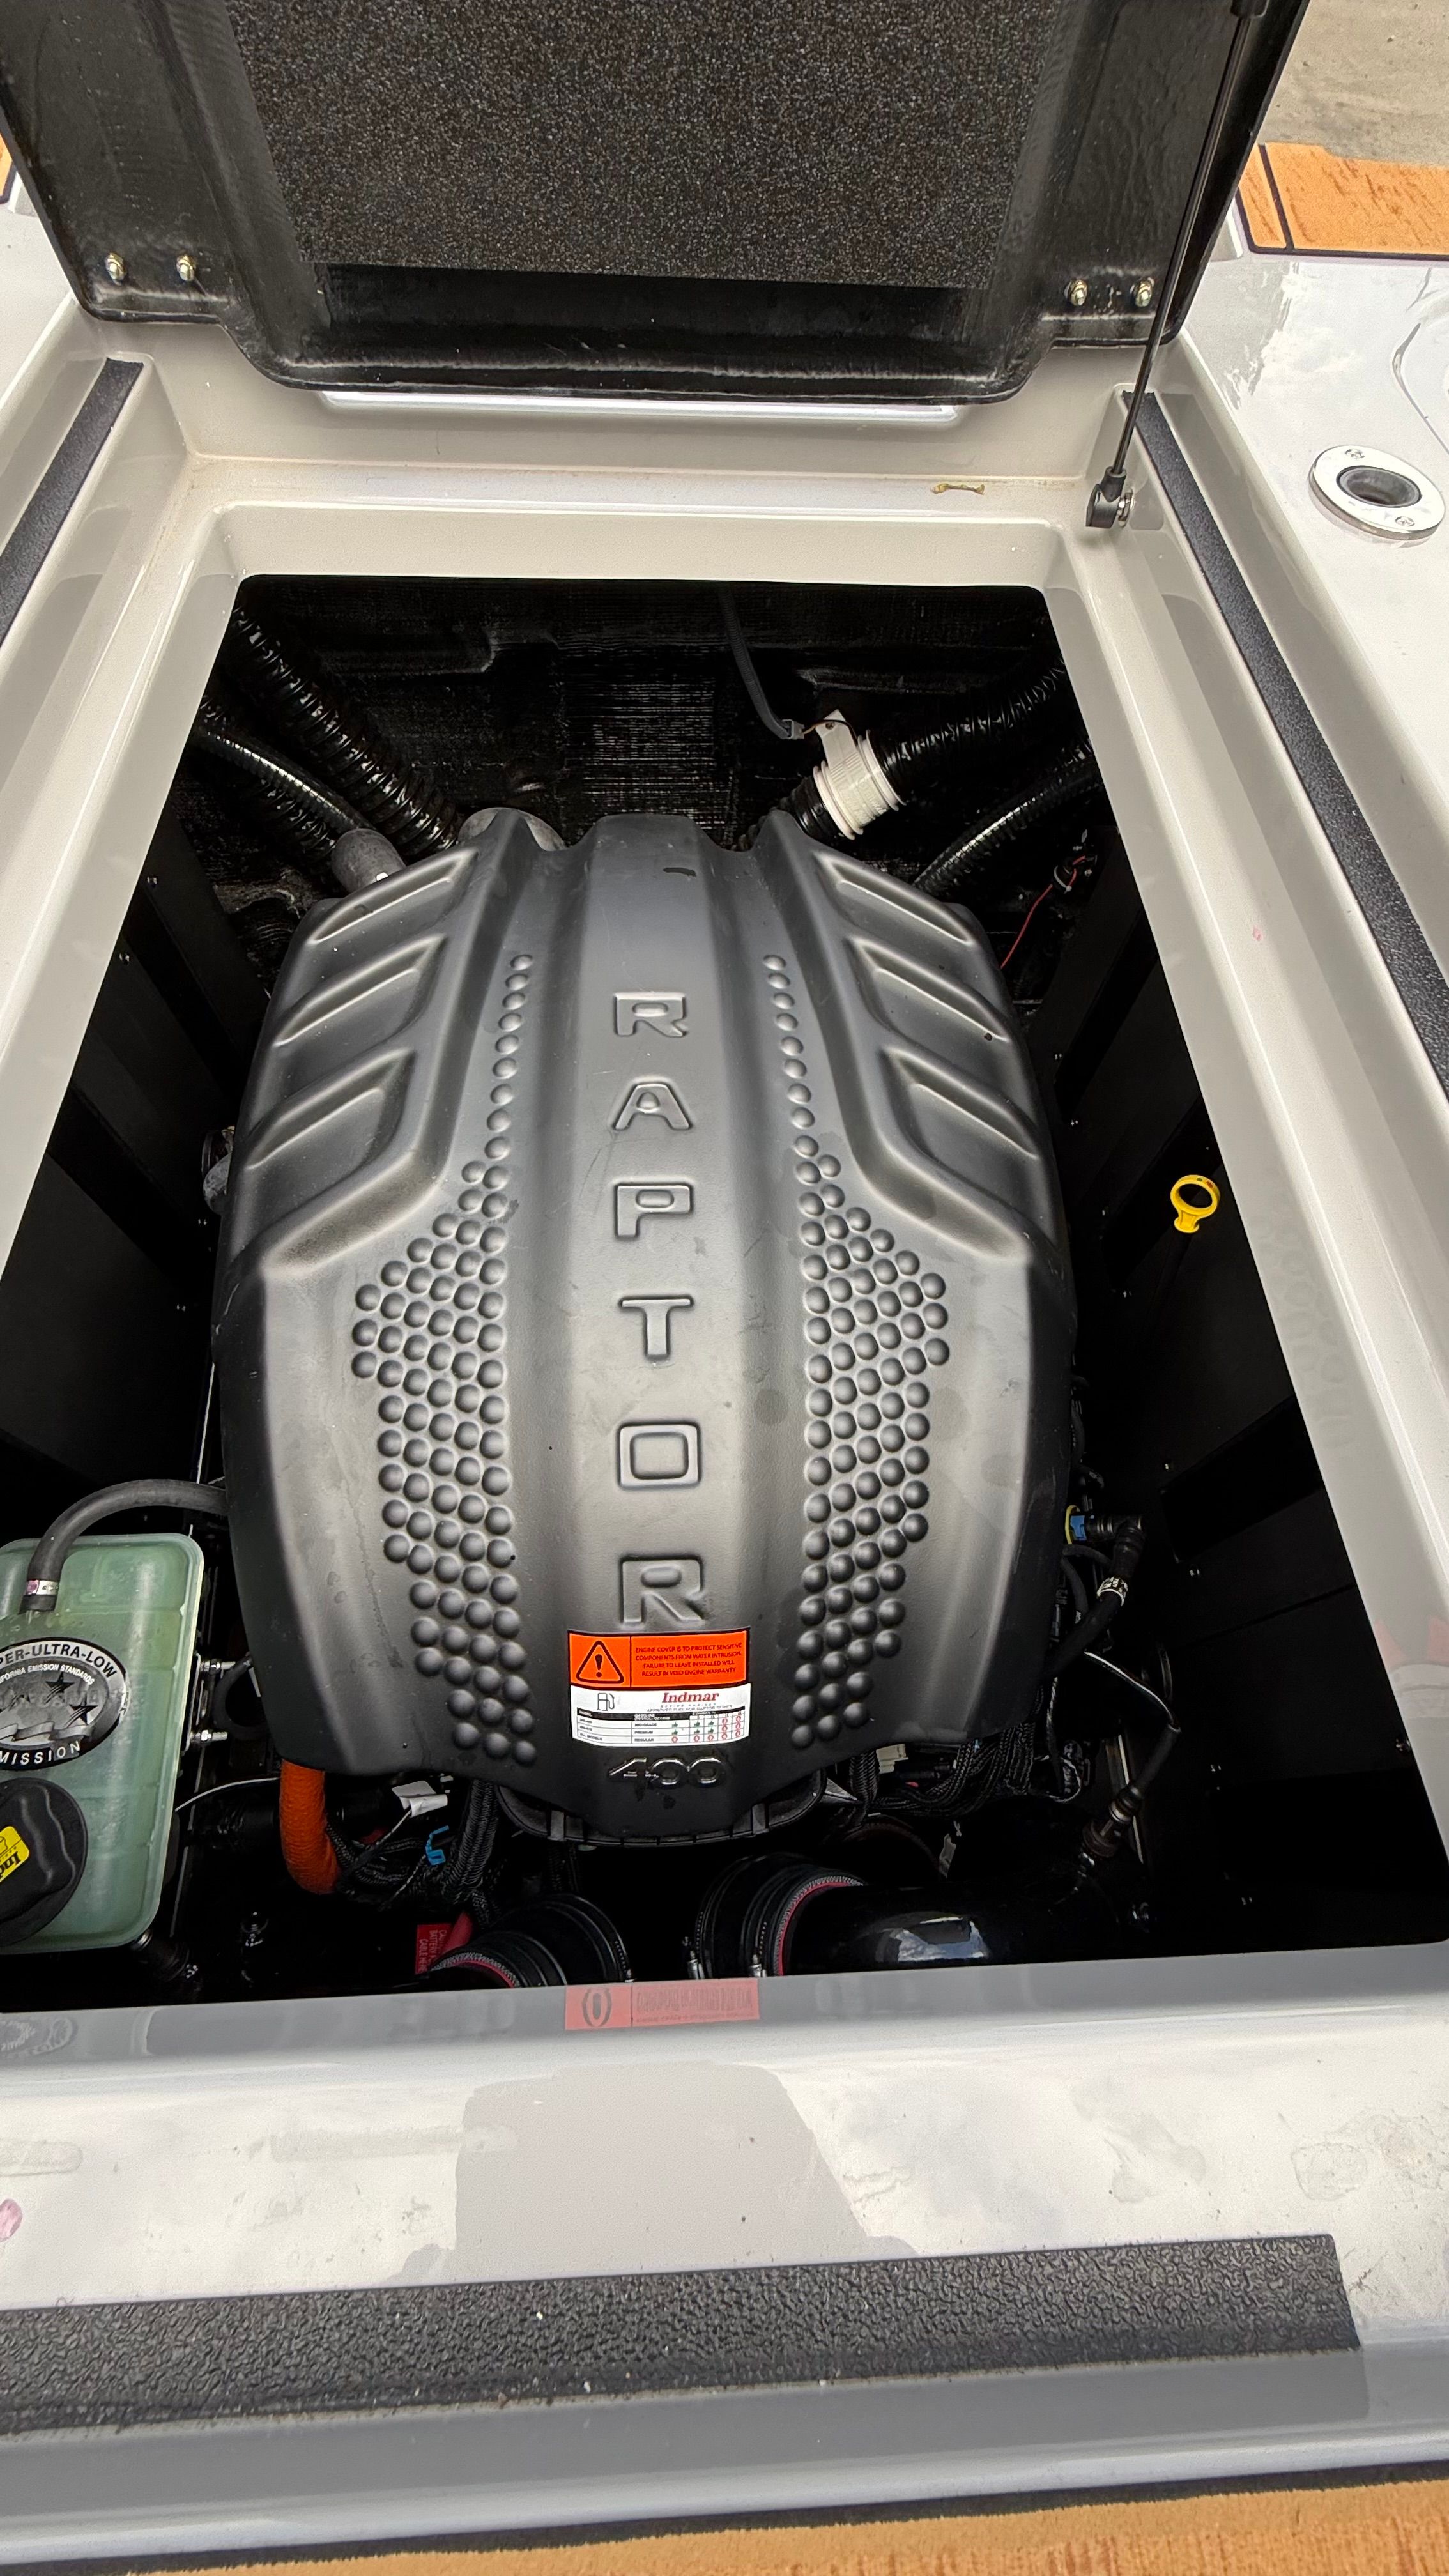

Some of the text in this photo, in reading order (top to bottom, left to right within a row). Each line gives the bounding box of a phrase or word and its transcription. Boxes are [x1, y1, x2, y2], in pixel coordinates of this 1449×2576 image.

[614, 992, 708, 1627] RAPTOR
[716, 1642, 742, 1650] SENSITIVE
[27, 1663, 60, 1672] EMISSION
[60, 1664, 95, 1685] STANDARDS
[661, 1692, 720, 1703] Indmar
[609, 1756, 726, 1786] 400
